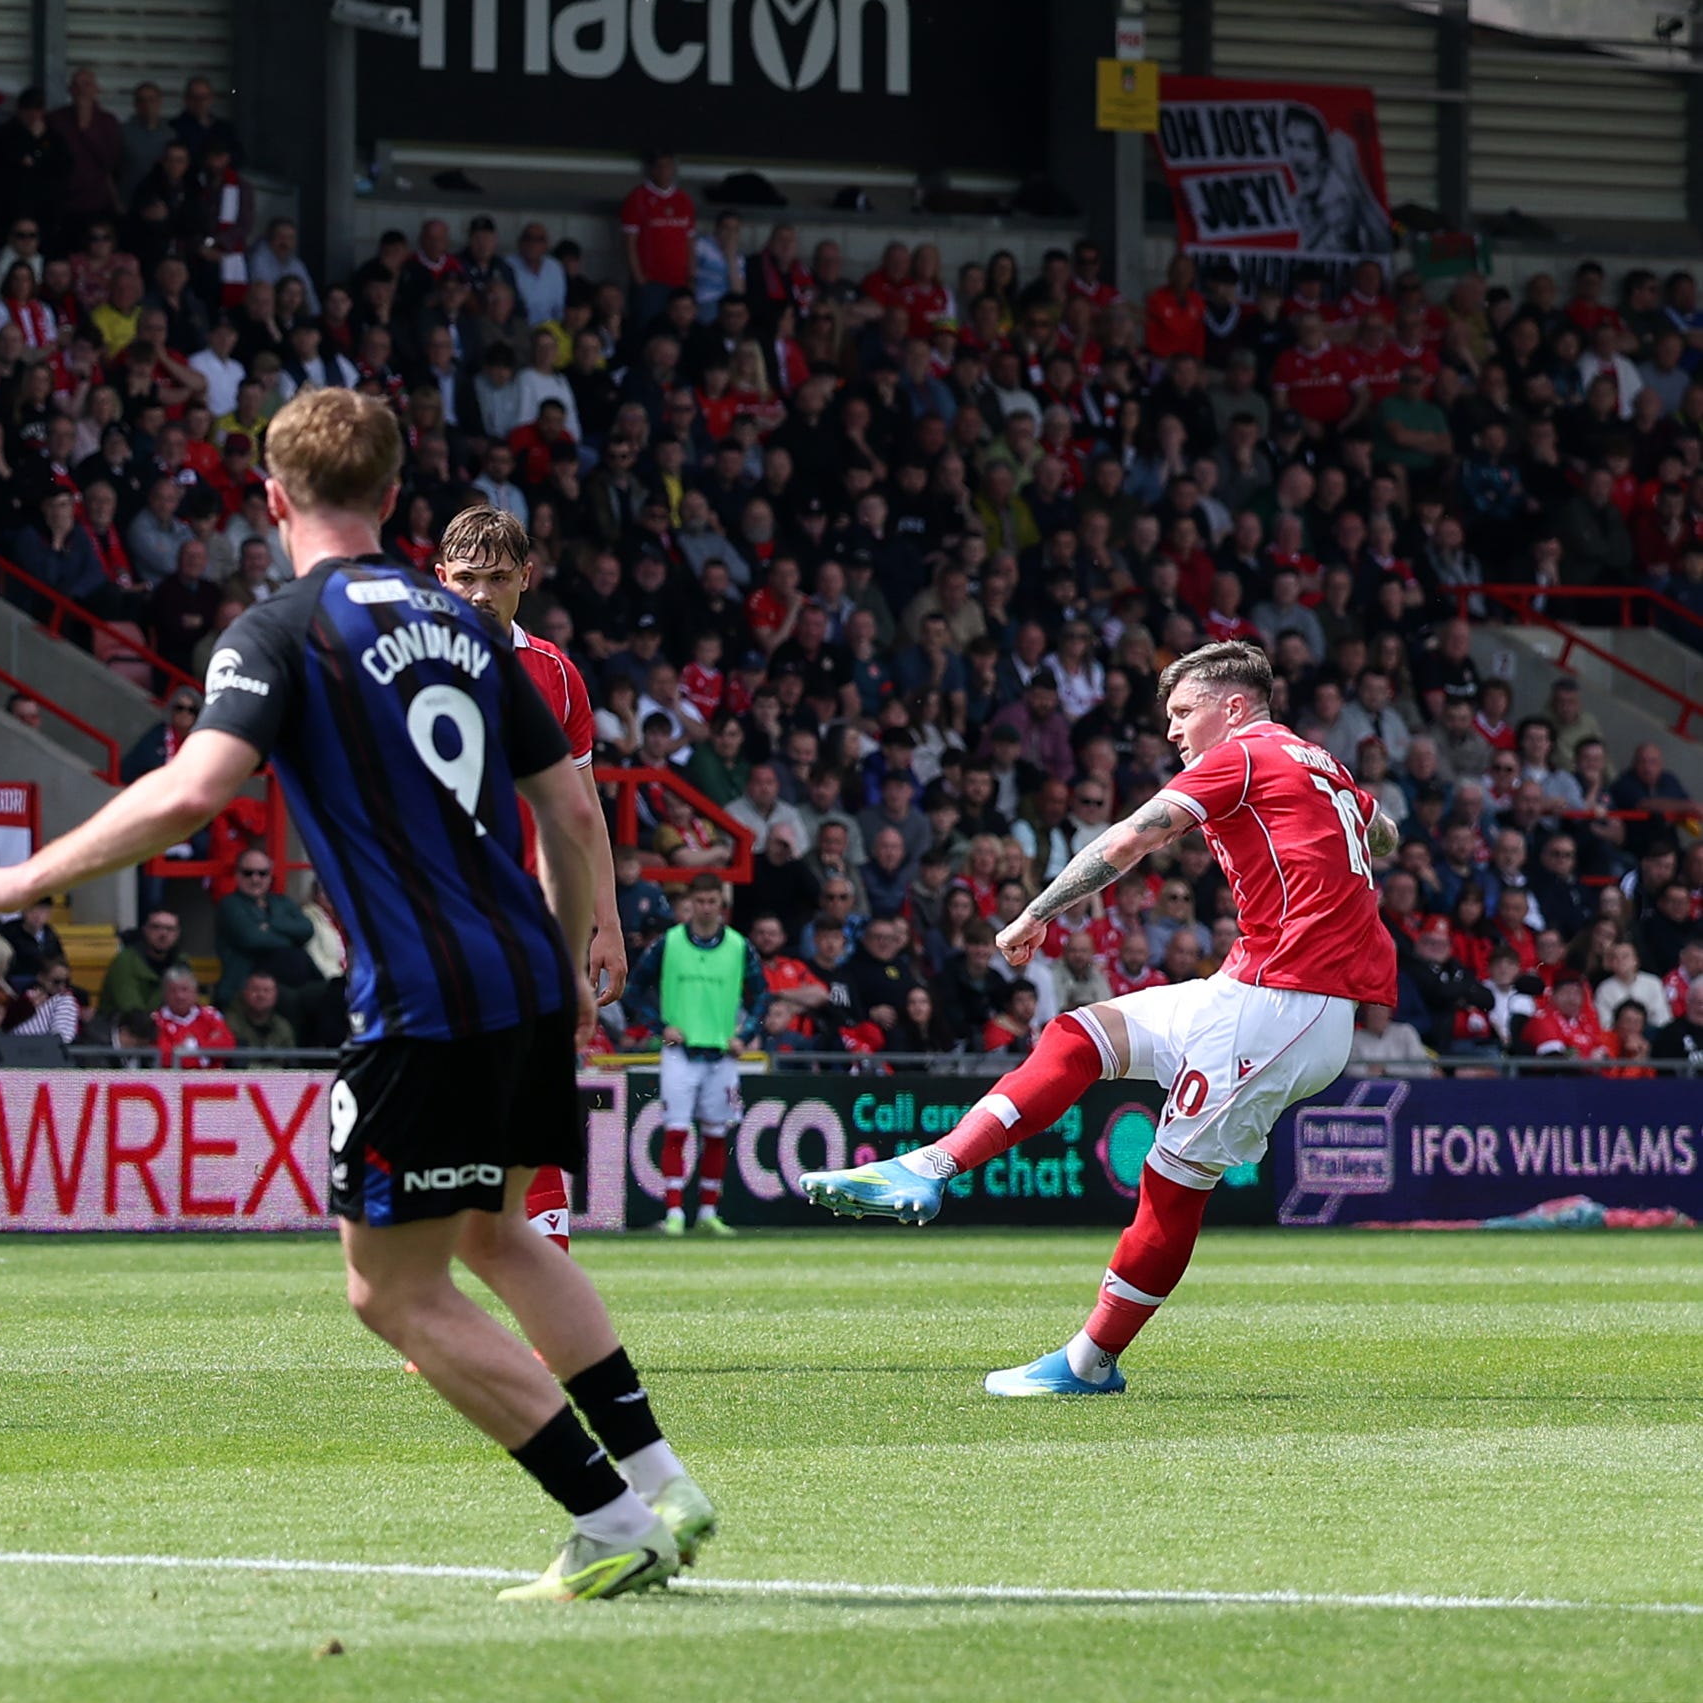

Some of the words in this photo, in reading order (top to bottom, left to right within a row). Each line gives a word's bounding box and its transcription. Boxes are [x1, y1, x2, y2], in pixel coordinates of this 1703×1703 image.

[1160, 108, 1207, 159] OH
[1207, 107, 1282, 158] JOEY
[1198, 176, 1291, 230] JOEY!
[361, 620, 492, 685] CONWAY
[406, 684, 487, 836] 9
[852, 1093, 916, 1134] Call
[983, 1145, 1085, 1199] chat
[1411, 1125, 1501, 1176] IFOR
[1508, 1125, 1697, 1176] WILLIAMS
[403, 1163, 504, 1193] NOCO
